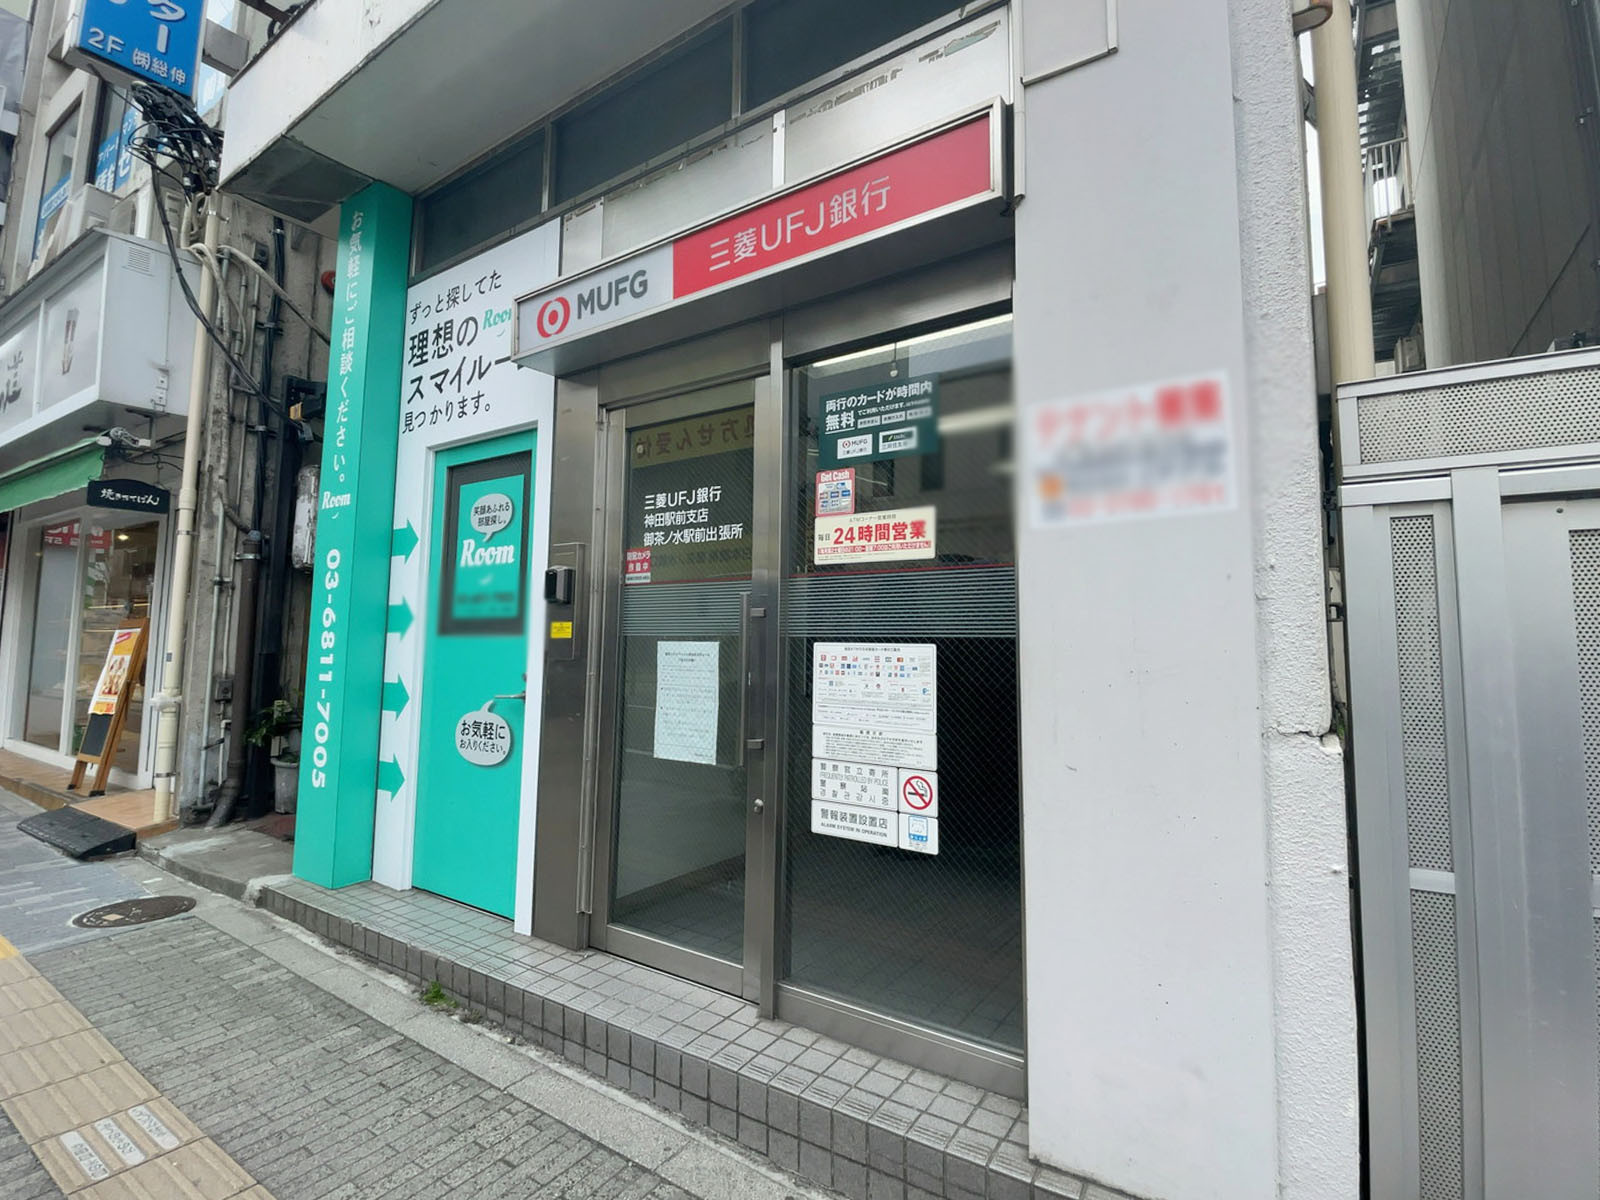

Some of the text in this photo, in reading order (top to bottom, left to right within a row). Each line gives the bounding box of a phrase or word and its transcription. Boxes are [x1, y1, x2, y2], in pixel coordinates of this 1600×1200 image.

[88, 27, 125, 53] 2F
[708, 176, 892, 272] 三菱UFJ銀行
[410, 269, 502, 325] ずっと探してた
[577, 270, 649, 320] MUFG
[332, 211, 364, 483] お気軽にご相談ください。
[408, 316, 478, 367] 理想の
[825, 381, 933, 413] 両行のカードが時間内
[402, 390, 491, 434] 見つかります。
[825, 411, 856, 431] 無料
[321, 491, 351, 509] Room
[473, 502, 510, 517] 笑顔あふれる
[644, 486, 722, 510] 三菱UFJ銀行
[644, 508, 708, 528] 神田駅前支店
[643, 523, 743, 547] 御茶ノ水駅前出張所
[833, 520, 928, 545] 24時間営業
[460, 538, 515, 568] Room
[311, 549, 341, 789] 03-6811-7005
[460, 720, 506, 740] お気軽に
[459, 739, 506, 755] お入りください。
